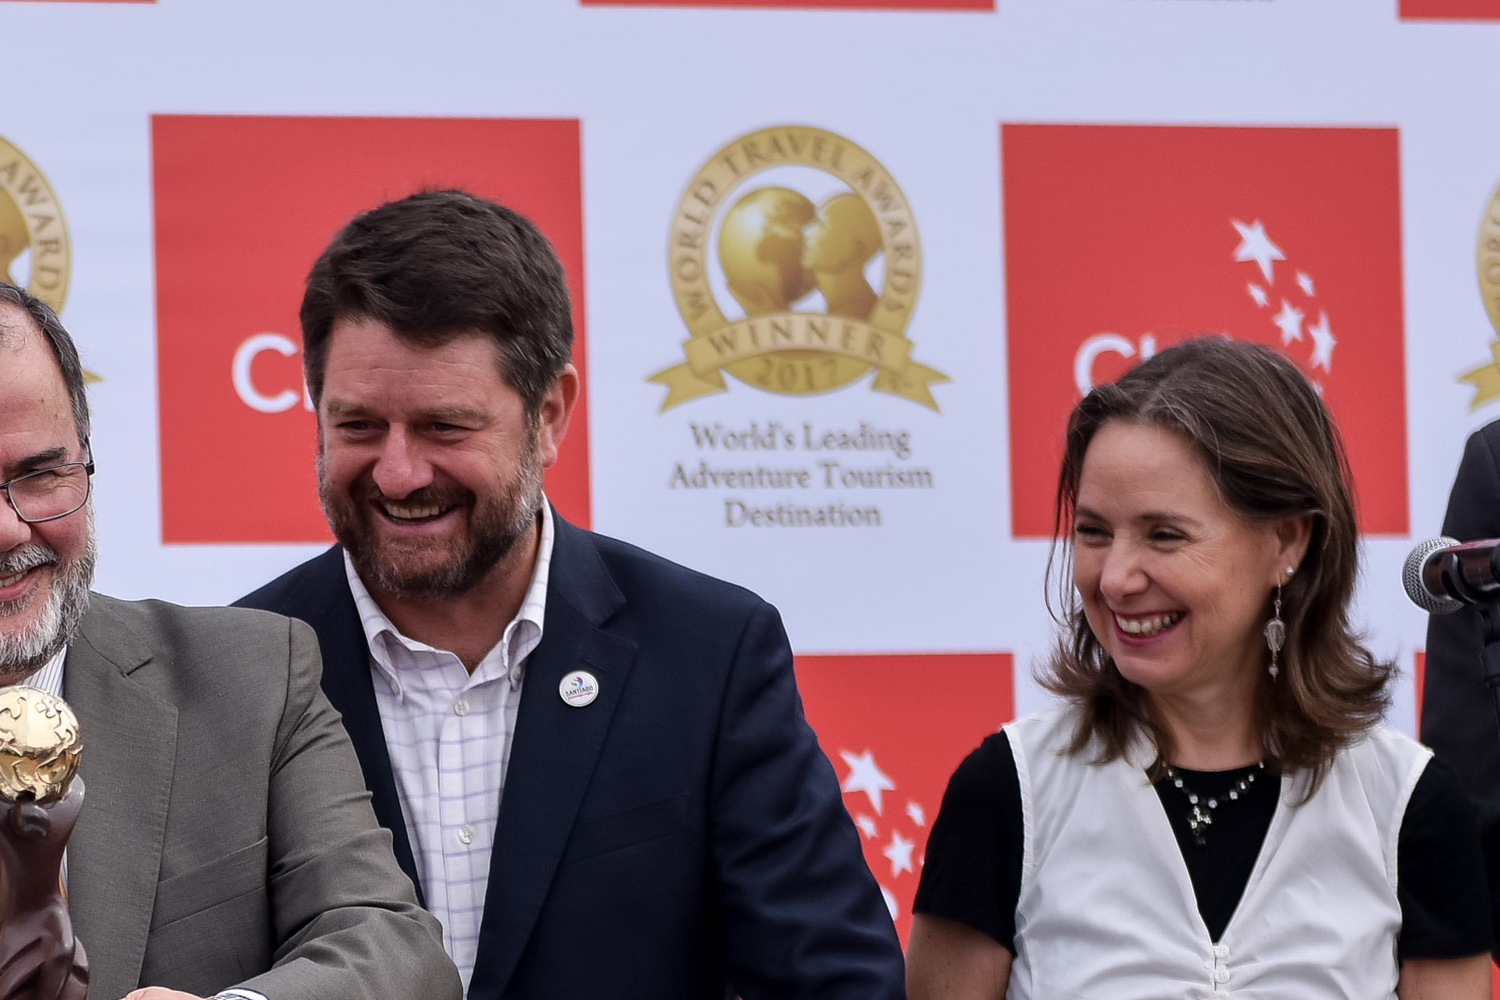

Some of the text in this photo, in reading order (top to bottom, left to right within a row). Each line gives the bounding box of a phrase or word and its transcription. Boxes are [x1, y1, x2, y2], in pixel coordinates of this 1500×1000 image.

[724, 133, 845, 175] TRAVEL
[709, 321, 885, 360] WINNER
[756, 357, 836, 391] 2017
[690, 420, 911, 460] World's Leading
[668, 460, 934, 489] Adventure Tourism
[724, 498, 882, 527] Destination
